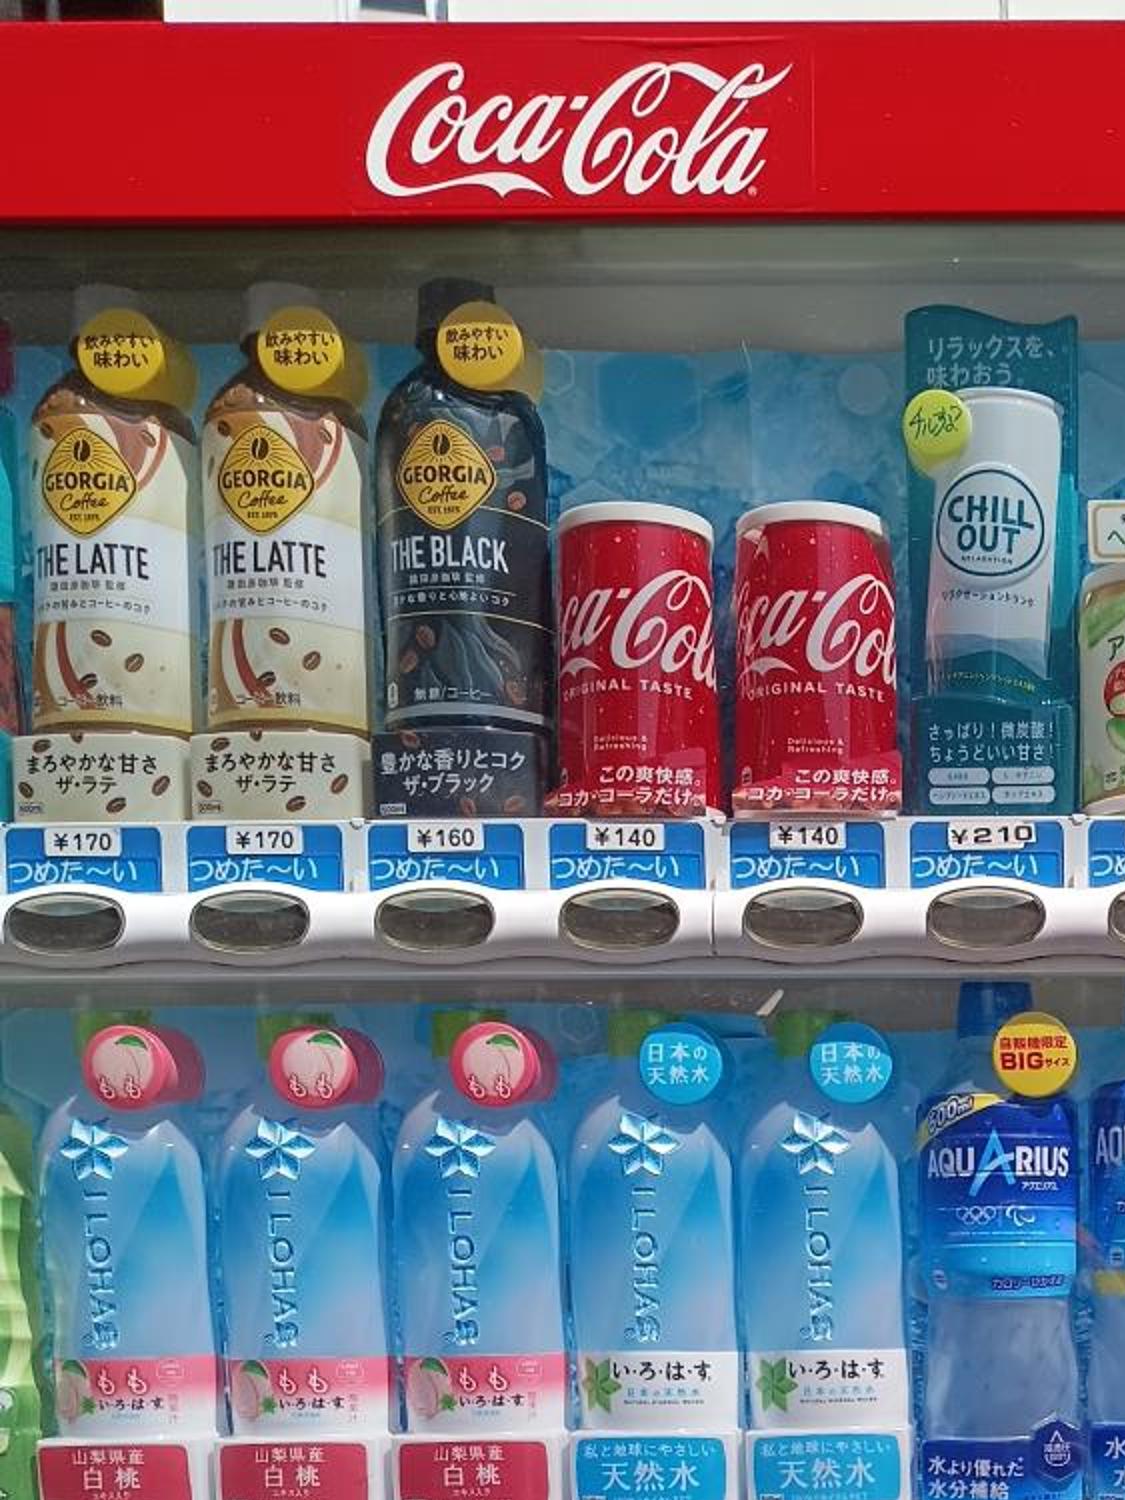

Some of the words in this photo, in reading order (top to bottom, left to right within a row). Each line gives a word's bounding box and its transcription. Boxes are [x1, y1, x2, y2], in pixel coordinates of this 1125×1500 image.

[364, 61, 793, 198] Coca-Cola
[82, 334, 160, 351] 飲みやすい
[93, 350, 149, 368] 味わい
[45, 471, 127, 494] GEORGIA
[222, 470, 307, 493] GEORGIA
[403, 465, 488, 487] GEORGIA
[59, 491, 108, 511] Coffee
[947, 495, 1035, 529] CHILL
[957, 524, 1021, 554] OUT
[37, 543, 69, 579] THE
[75, 543, 150, 581] LATTE
[253, 540, 327, 578] LATTE
[430, 534, 510, 575] BLACK
[639, 679, 694, 700] TASTE
[835, 682, 887, 703] TASTE
[26, 754, 159, 776] まろやかな甘さ
[205, 753, 337, 775] まろやかな甘さ
[380, 747, 526, 776] 豊かな香りとコク
[55, 774, 118, 794] ザ・ラテ
[402, 772, 495, 797] ザ・ブラック
[599, 765, 703, 787] この爽快感。
[53, 831, 112, 852] ¥170
[416, 827, 476, 848] ¥160
[594, 827, 656, 848] ¥140
[950, 825, 1033, 845] ¥210
[647, 1042, 708, 1063] 日本の
[646, 1064, 710, 1085] 天然水
[819, 1064, 886, 1085] 天然水
[927, 1127, 1071, 1197] AQUARIUS
[71, 1448, 146, 1466] 山梨県産
[583, 1443, 717, 1460] 私と地球にやさしい
[83, 1466, 142, 1491] 白桃
[600, 1458, 701, 1494] 天然水
[776, 1456, 877, 1490] 天然水
[927, 1478, 1010, 1500] 水分補給
